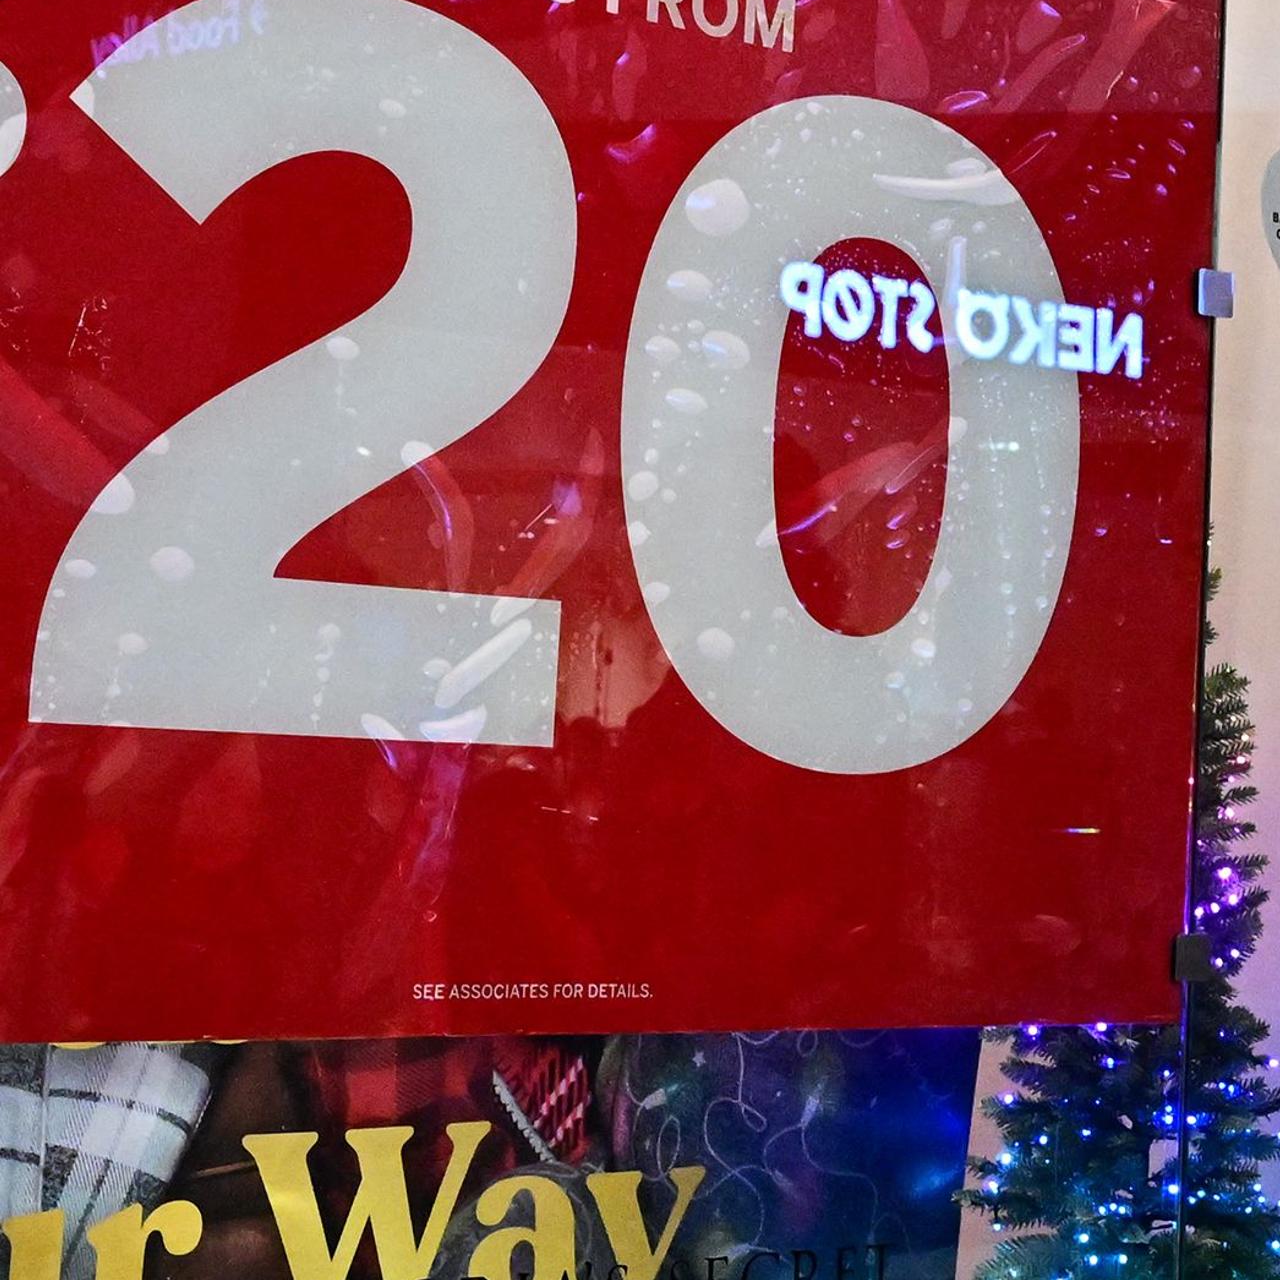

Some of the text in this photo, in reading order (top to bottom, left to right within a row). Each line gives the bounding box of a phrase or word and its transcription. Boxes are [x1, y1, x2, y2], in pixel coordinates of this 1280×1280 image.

[413, 983, 653, 1000] SEE ASSOCIATES FOR DETAILS.
